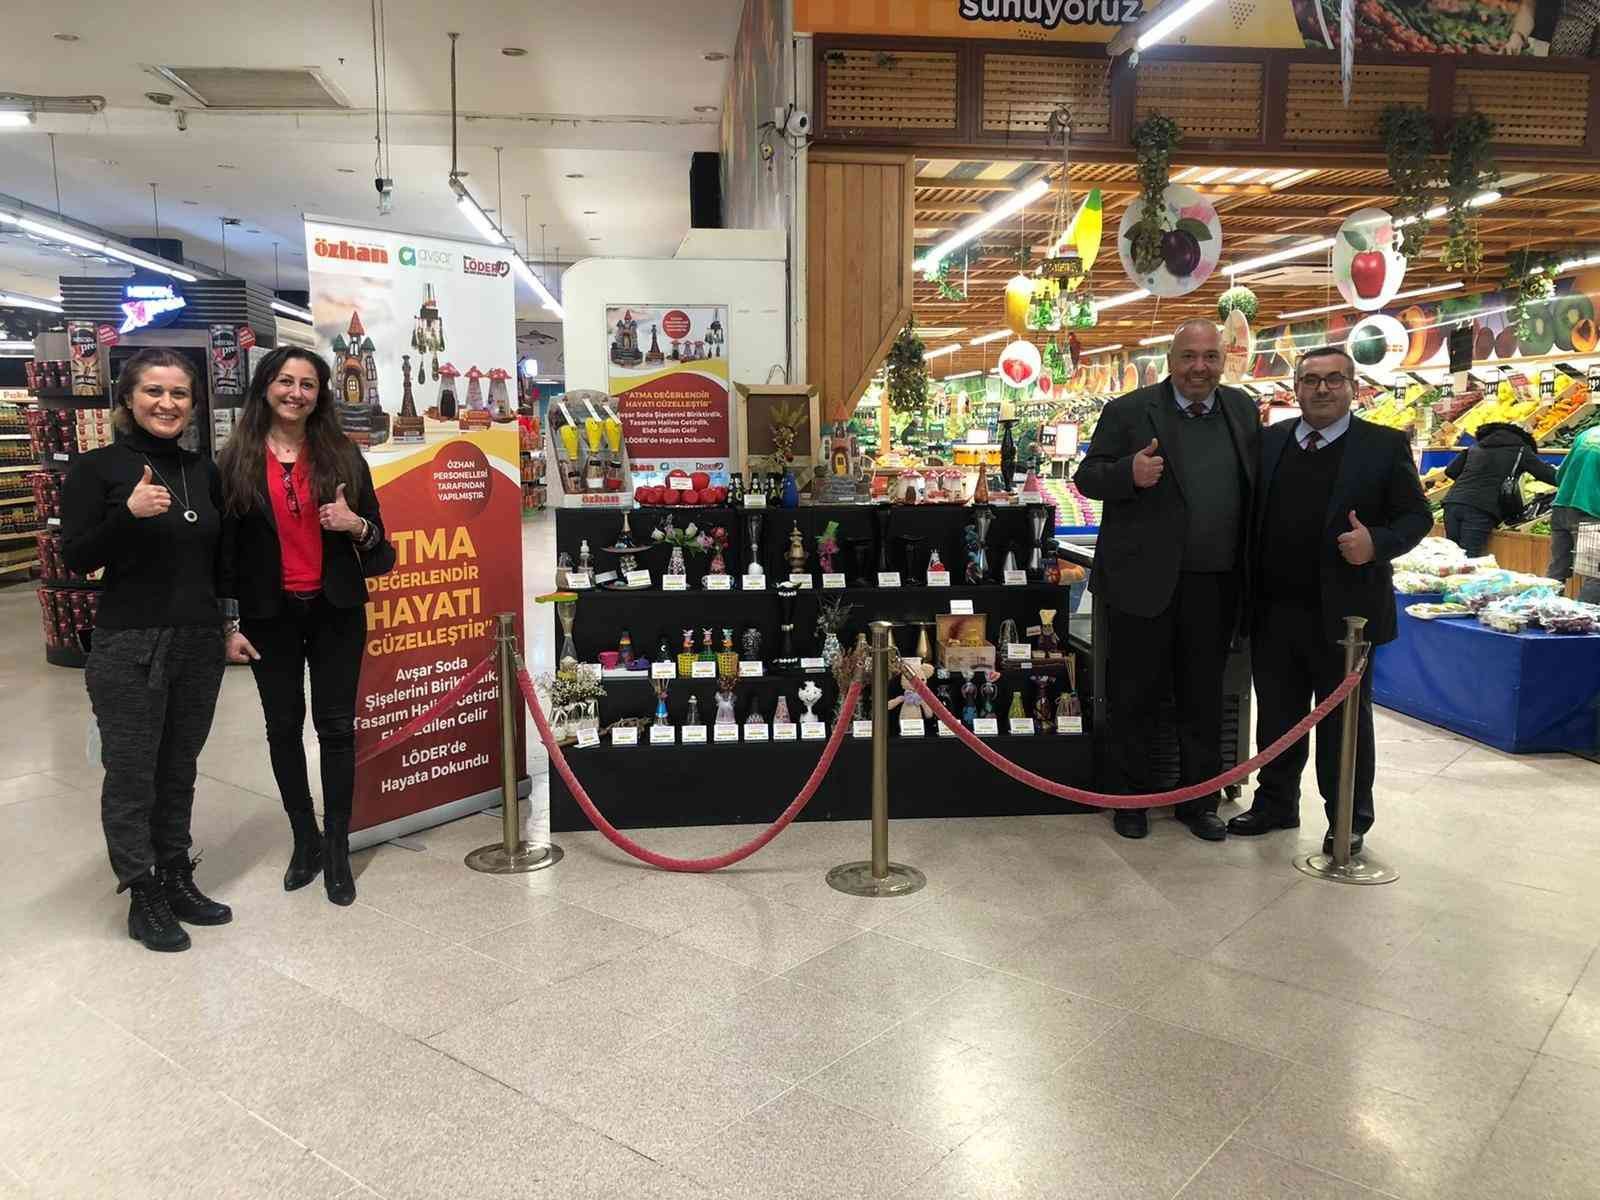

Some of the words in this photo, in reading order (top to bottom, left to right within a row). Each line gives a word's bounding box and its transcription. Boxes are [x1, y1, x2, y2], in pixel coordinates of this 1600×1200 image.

[961, 0, 1139, 26] sunuyoruz
[314, 238, 388, 264] özhan
[433, 471, 488, 480] PERSONELLERİ
[447, 459, 475, 469] ÖZHAN
[438, 481, 485, 489] TARAFINDAN
[438, 491, 484, 501] YAPILMIŞTIR
[391, 526, 477, 566] TMA
[365, 562, 479, 593] DEĞERLENDİR
[364, 587, 480, 631] HAYATI
[367, 619, 493, 656] GÜZELLEŞTİR"
[395, 663, 432, 682] Avşar
[435, 657, 468, 674] Soda
[365, 683, 428, 711] Şişelerini
[353, 709, 408, 730] Tasarım
[457, 708, 488, 726] Gelir
[402, 741, 467, 767] LÖDER'de
[381, 768, 429, 793] Hayata
[431, 751, 489, 778] Dokundu
